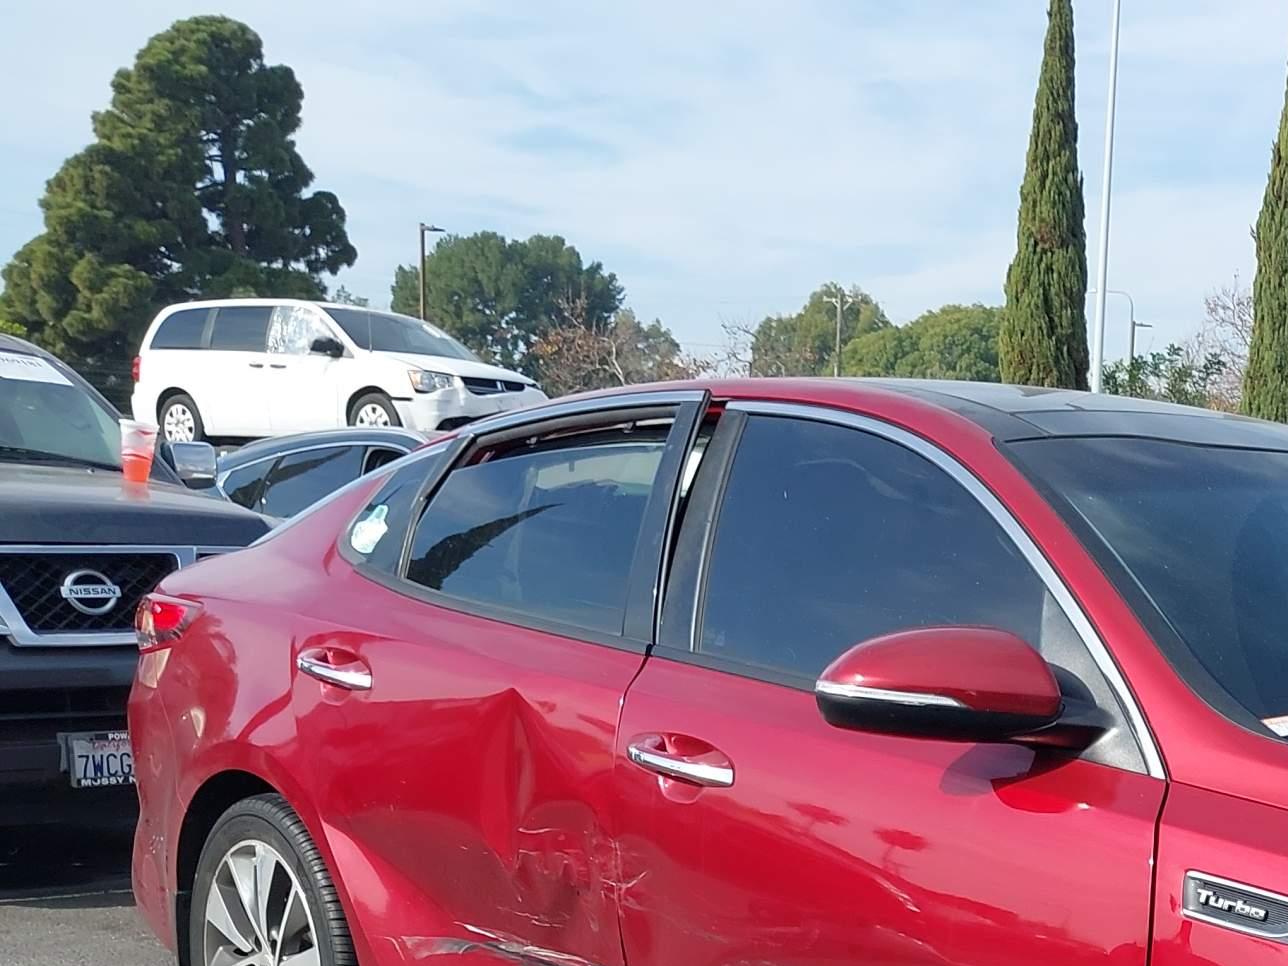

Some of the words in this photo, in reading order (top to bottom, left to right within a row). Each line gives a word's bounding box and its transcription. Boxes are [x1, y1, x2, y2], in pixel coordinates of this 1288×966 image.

[69, 587, 116, 596] NISSAN
[78, 753, 132, 778] 7WCG
[1197, 888, 1267, 922] Turbo
